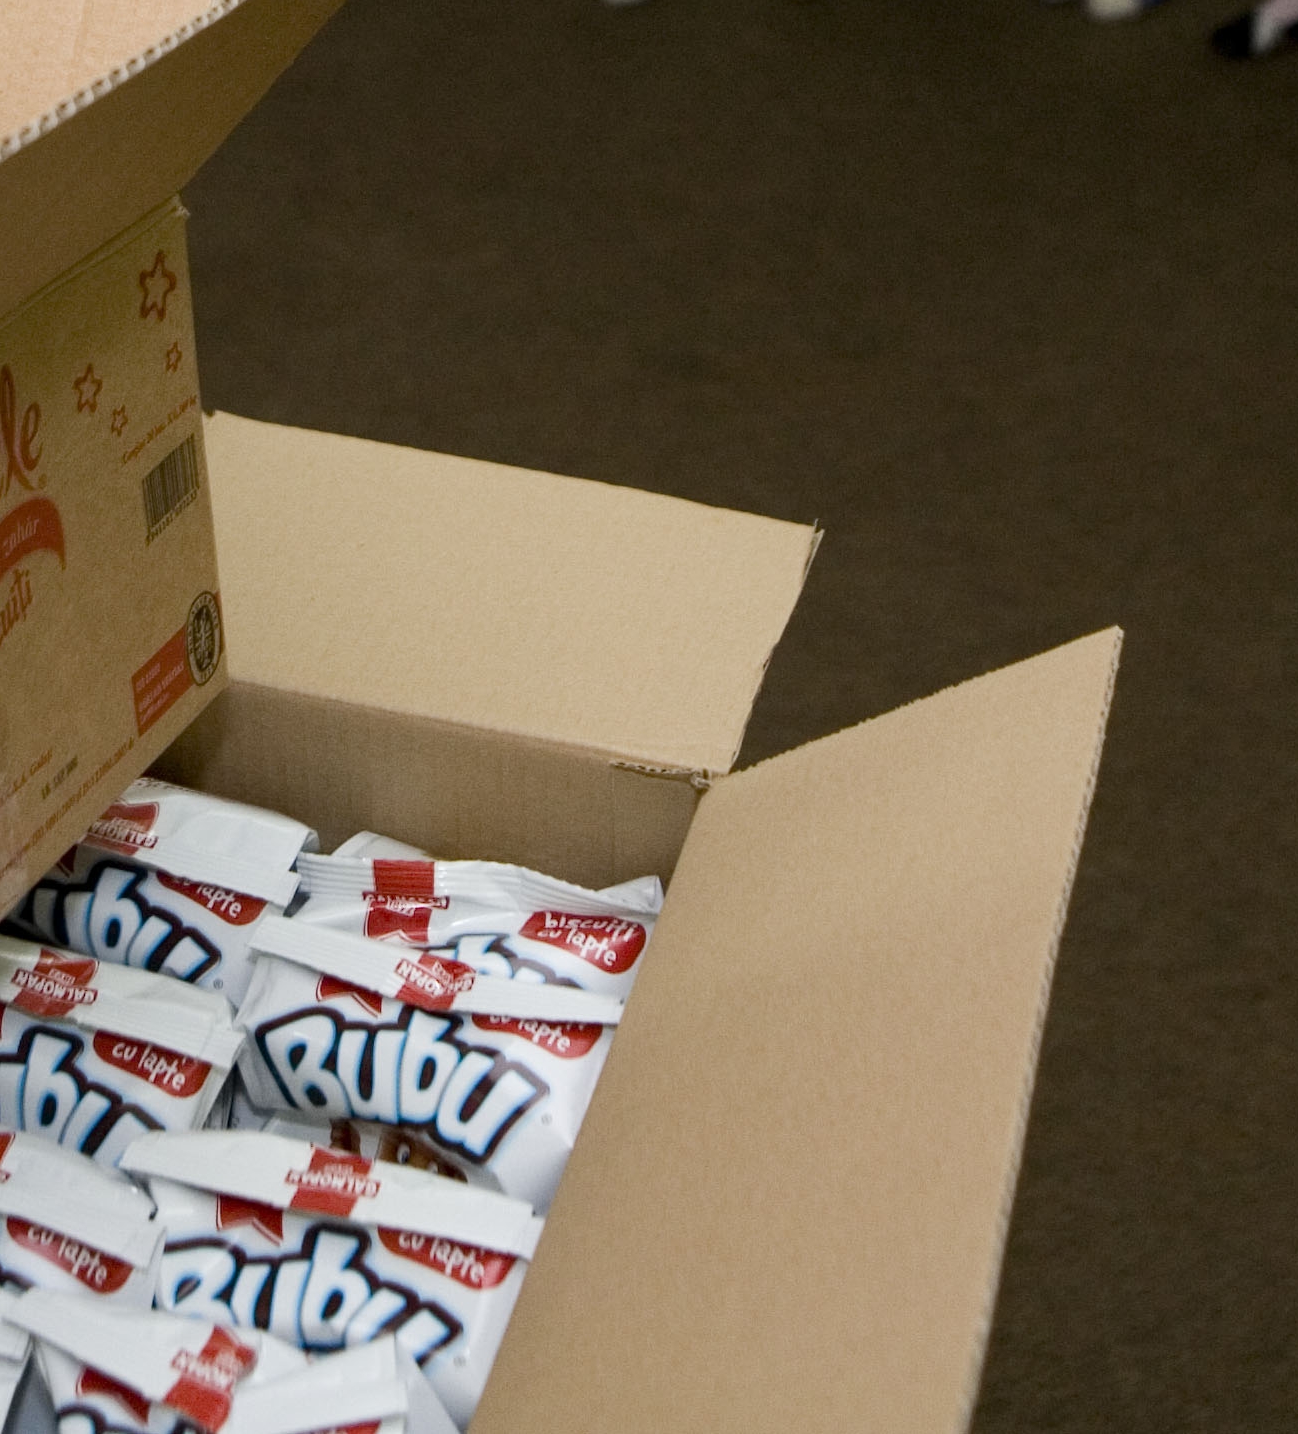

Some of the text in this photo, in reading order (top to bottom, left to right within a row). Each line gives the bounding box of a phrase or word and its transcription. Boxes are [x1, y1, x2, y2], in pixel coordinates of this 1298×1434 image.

[91, 819, 158, 849] GALMOPA
[18, 860, 221, 982] ubu
[564, 926, 617, 966] lapte
[13, 970, 97, 1004] GALMOPAN
[518, 1015, 572, 1053] lapte
[112, 1041, 187, 1091] cu lapte
[255, 1006, 549, 1165] Bubu
[27, 1227, 108, 1286] cu lapte
[429, 1235, 487, 1283] lapte
